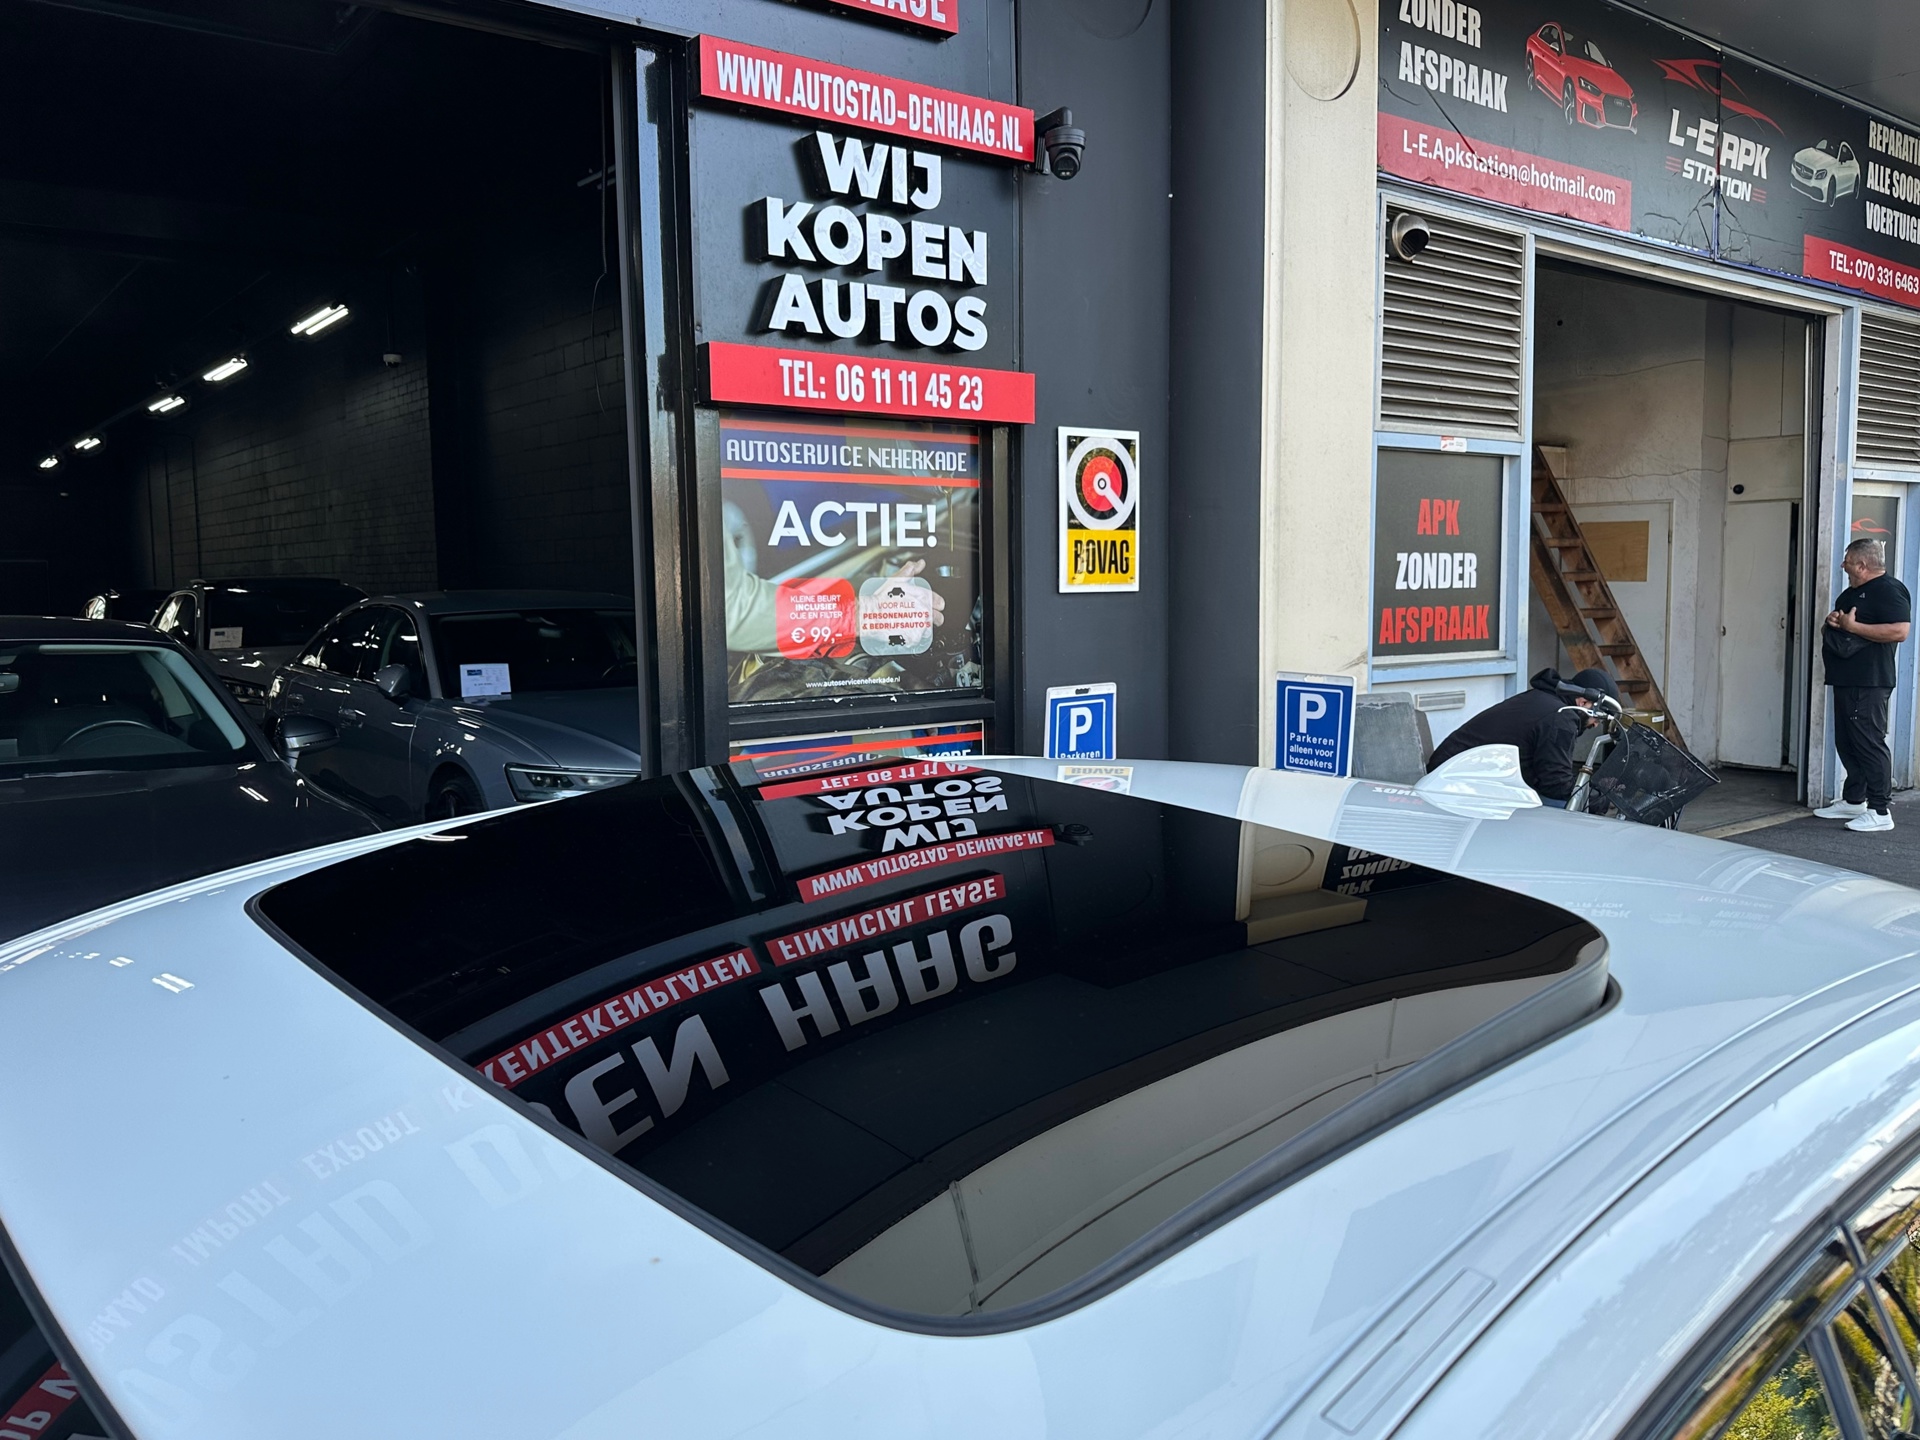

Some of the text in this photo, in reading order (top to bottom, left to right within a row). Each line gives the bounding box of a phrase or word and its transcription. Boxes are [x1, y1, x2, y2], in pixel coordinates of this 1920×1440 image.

[1399, 0, 1481, 48] ZONDER
[1398, 41, 1508, 113] AFSPRAAK
[716, 50, 1023, 153] WWW.AUTOSTAD-DENHAAG.NL
[1668, 108, 1771, 180] L-E APK
[816, 131, 942, 210] WIJ
[1403, 129, 1616, 206] L-E.Apkstation@hotmail.com
[1682, 158, 1752, 202] STATION
[1866, 161, 1891, 196] ALLE
[767, 196, 987, 286] KOPEN
[1829, 250, 1919, 295] TEL: 070 331 6463
[768, 273, 988, 351] AUTOS
[779, 359, 983, 411] TEL: 06 11 11 45 23
[726, 439, 967, 472] AUTOSERVICE NEHERKADE
[768, 500, 938, 548] ACTIE!
[1417, 499, 1460, 535] APK
[1074, 539, 1130, 575] BOVAG
[1395, 552, 1477, 590] ZONDER
[790, 594, 841, 603] KLEINE BEURT
[790, 612, 808, 620] OLIE
[819, 611, 843, 619] FILTER
[795, 603, 837, 611] INCLUSIEF
[863, 611, 929, 620] PERSONENAUTO'S
[900, 601, 915, 609] ALLE
[791, 626, 843, 644] € 99,-
[869, 621, 931, 630] BEDRIJFSAUTO'S
[1379, 605, 1489, 645] AFSPRAAK
[806, 676, 901, 688] www.autoserviceneherkade.nl
[1069, 706, 1092, 752] P
[1299, 692, 1327, 734] P
[1289, 732, 1334, 746] Parkeren
[1289, 744, 1334, 758] alleen voor
[1289, 755, 1333, 770] bezoekers
